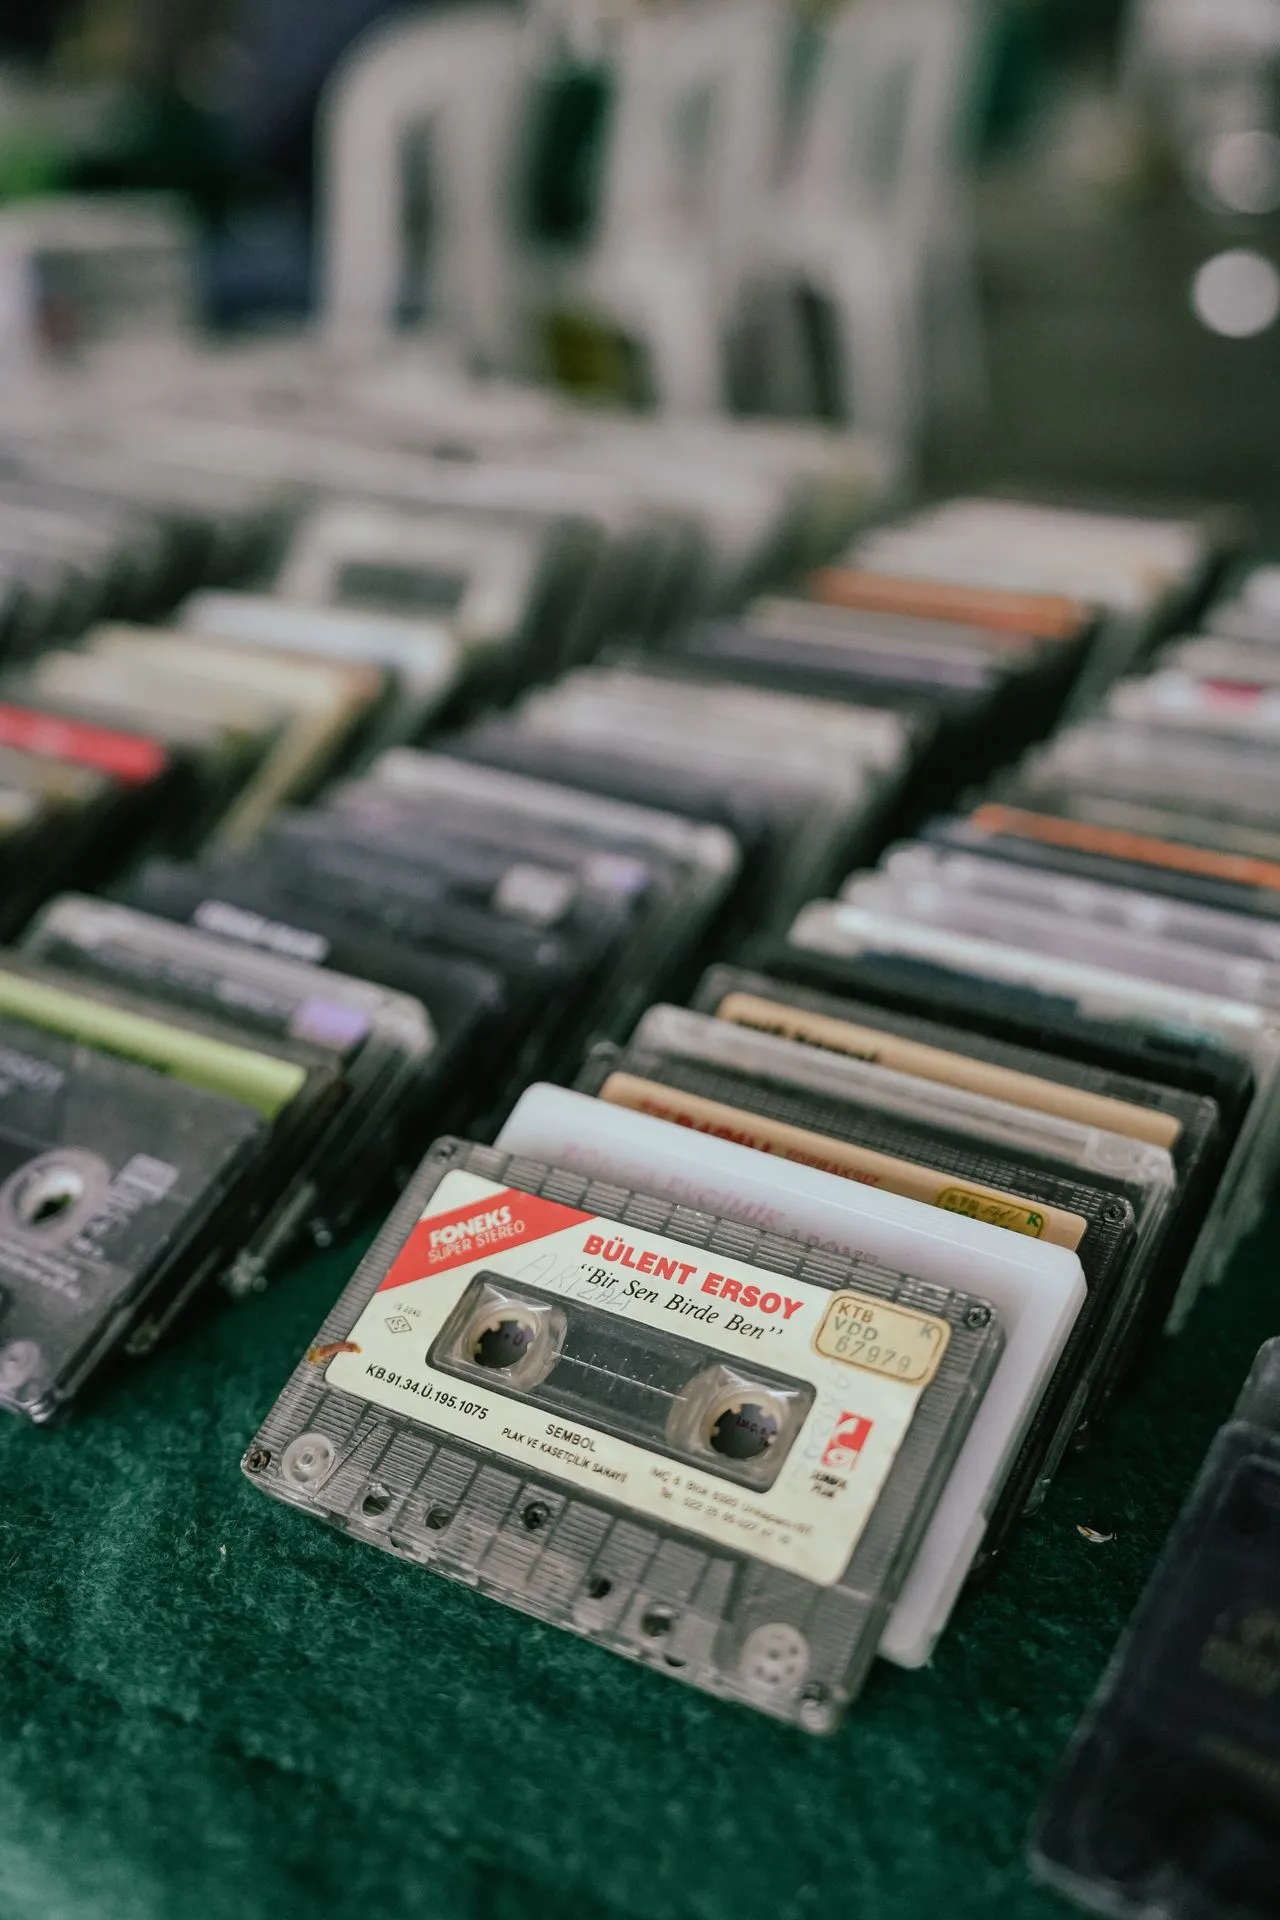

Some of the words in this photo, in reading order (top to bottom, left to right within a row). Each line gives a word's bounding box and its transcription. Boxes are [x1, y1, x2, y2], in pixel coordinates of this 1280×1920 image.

[428, 1238, 472, 1264] SUPER
[475, 1219, 526, 1248] STEREO
[429, 1206, 512, 1248] FONEKS
[582, 1234, 698, 1286] BÜLENT
[701, 1272, 805, 1320] ERSOY
[622, 1279, 660, 1304] Sen
[664, 1294, 720, 1324] Birde
[838, 1302, 875, 1323] KTB
[920, 1323, 936, 1340] K
[365, 1363, 489, 1420] KB.91.34.Ü.195.1075
[501, 1427, 526, 1444] PLAK
[526, 1436, 539, 1449] VE
[545, 1424, 596, 1452] SEMBOL
